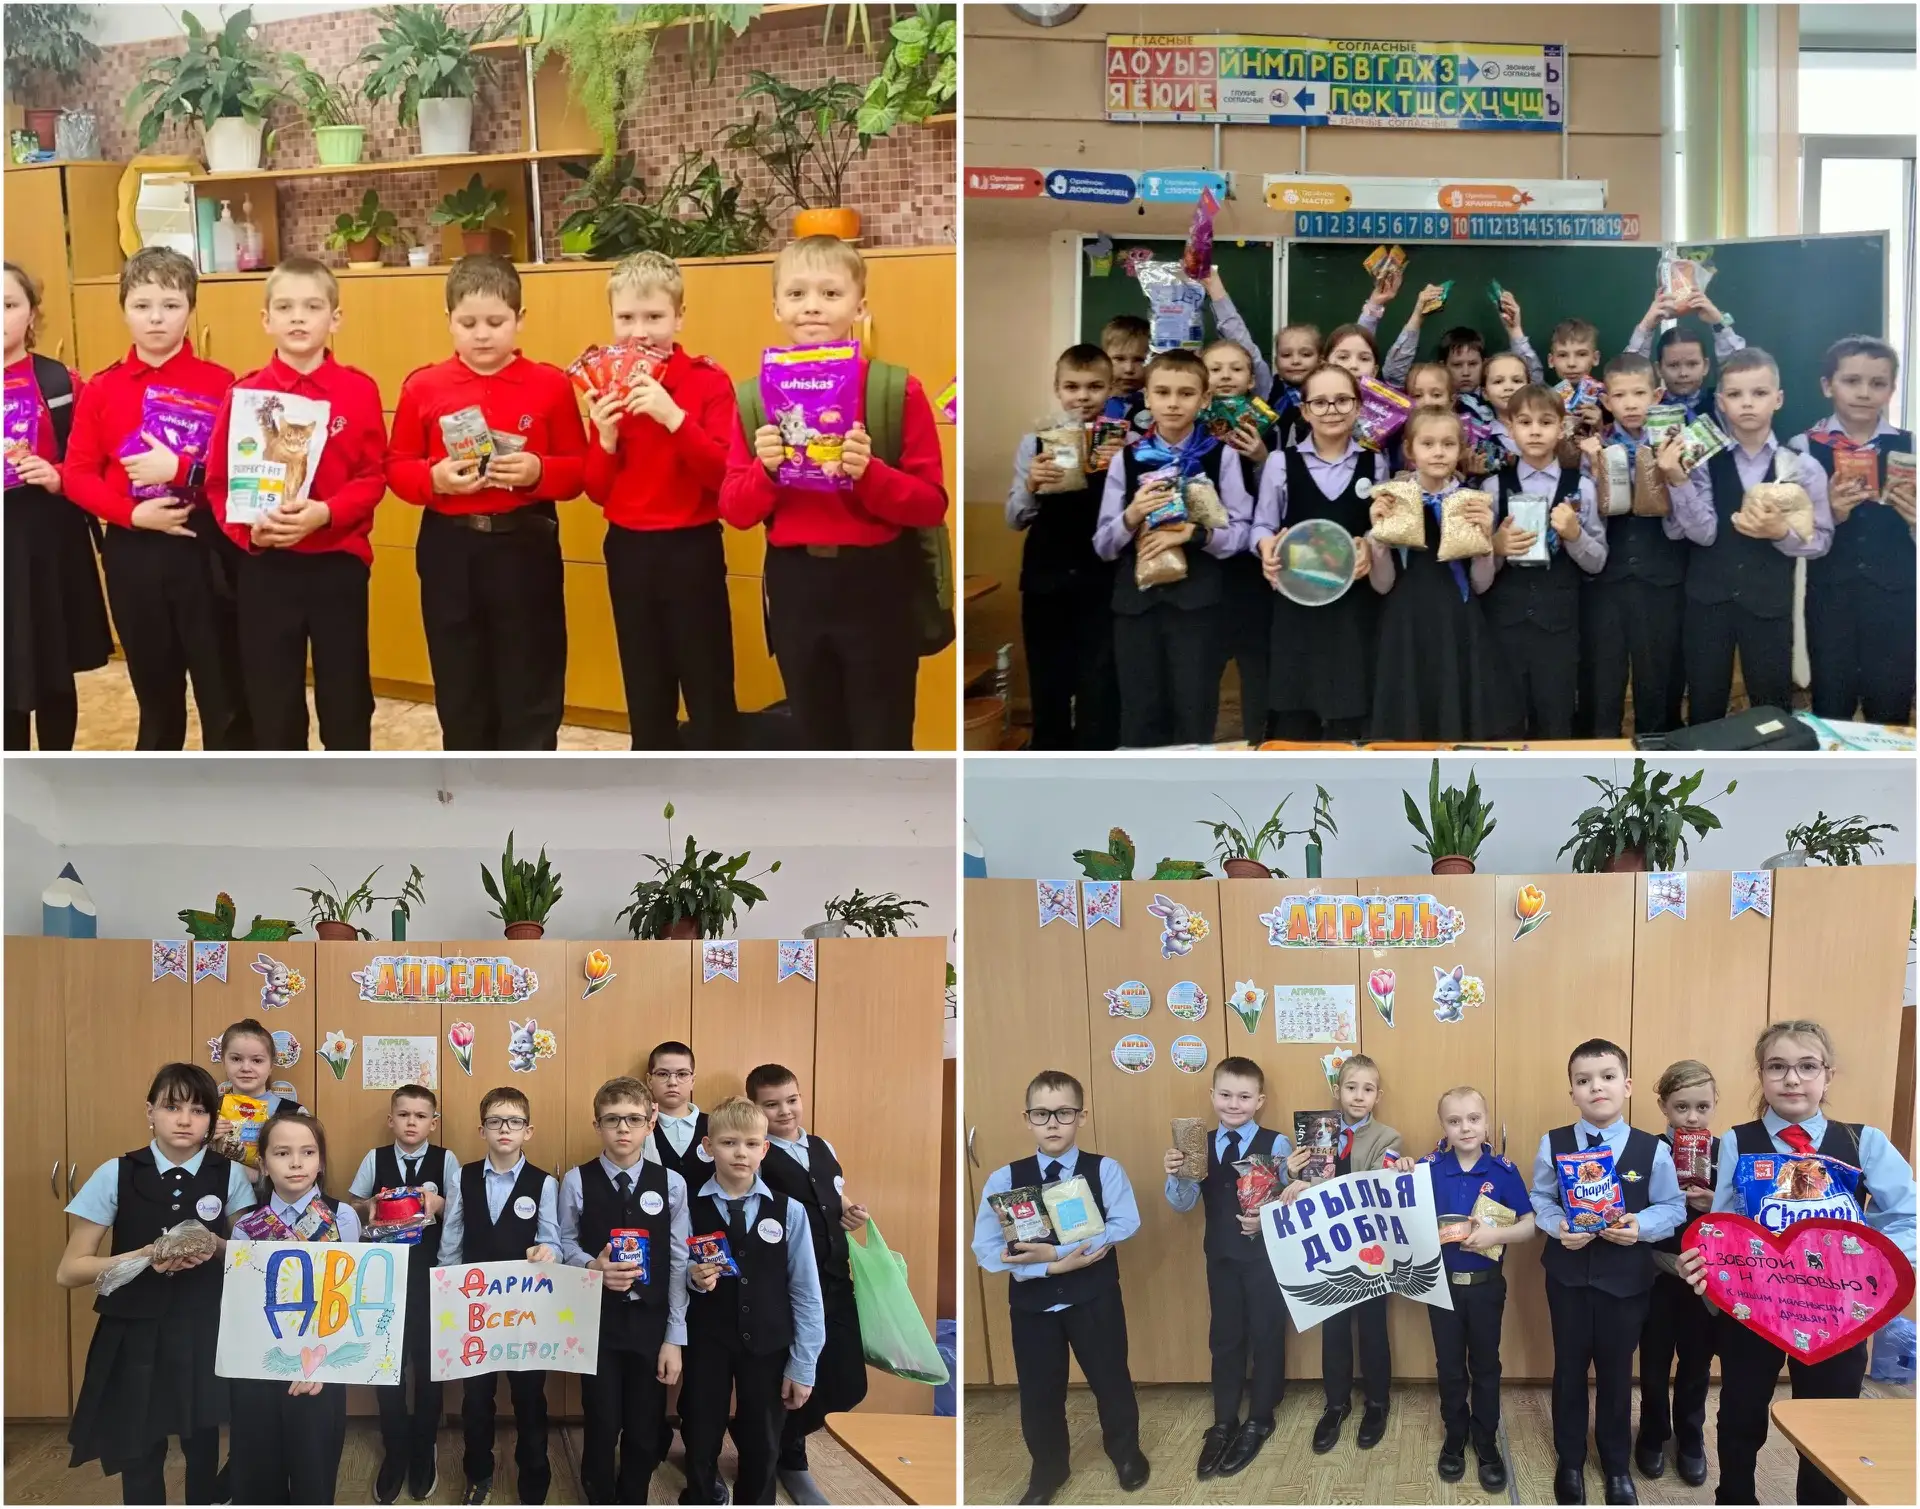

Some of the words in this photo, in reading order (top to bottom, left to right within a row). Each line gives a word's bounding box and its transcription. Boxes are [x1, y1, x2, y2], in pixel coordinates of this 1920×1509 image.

[1336, 41, 1417, 53] СОГЛАСНЫЕ
[1339, 118, 1383, 127] ПАРНЫЕ
[1068, 186, 1129, 198] ДОБРОВОЛЕЦ
[1163, 187, 1217, 196] СПОРТСН
[1301, 198, 1335, 206] МАСТЕР
[1299, 215, 1309, 233] 0
[1315, 215, 1323, 233] 1
[1330, 215, 1340, 233] 2
[1346, 215, 1355, 233] 3
[1361, 216, 1372, 233] 4
[1377, 216, 1387, 234] 5
[1393, 216, 1403, 234] 6
[1408, 217, 1418, 234] 7
[1424, 216, 1434, 234] 8
[1440, 217, 1449, 234] 9
[1454, 217, 1467, 234] 10
[1471, 217, 1484, 235] 11
[1487, 217, 1502, 235] 12
[1505, 217, 1519, 235] 13
[1522, 217, 1537, 236] 14
[1540, 217, 1554, 236] 15
[1556, 217, 1571, 236] 16
[1573, 217, 1588, 236] 17
[1589, 217, 1605, 236] 18
[1607, 218, 1621, 236] 19
[1623, 218, 1639, 236] 20
[781, 377, 834, 390] whiskas
[1287, 903, 1439, 941] АПРЕЛЬ
[376, 963, 515, 997] АПРЕЛЬ
[1573, 1178, 1611, 1200] Chappi
[1272, 1173, 1417, 1239] КРЫЛЬЯ
[1301, 1213, 1410, 1273] ДОБРА
[618, 1251, 642, 1261] Chappi
[701, 1252, 725, 1264] Chappi
